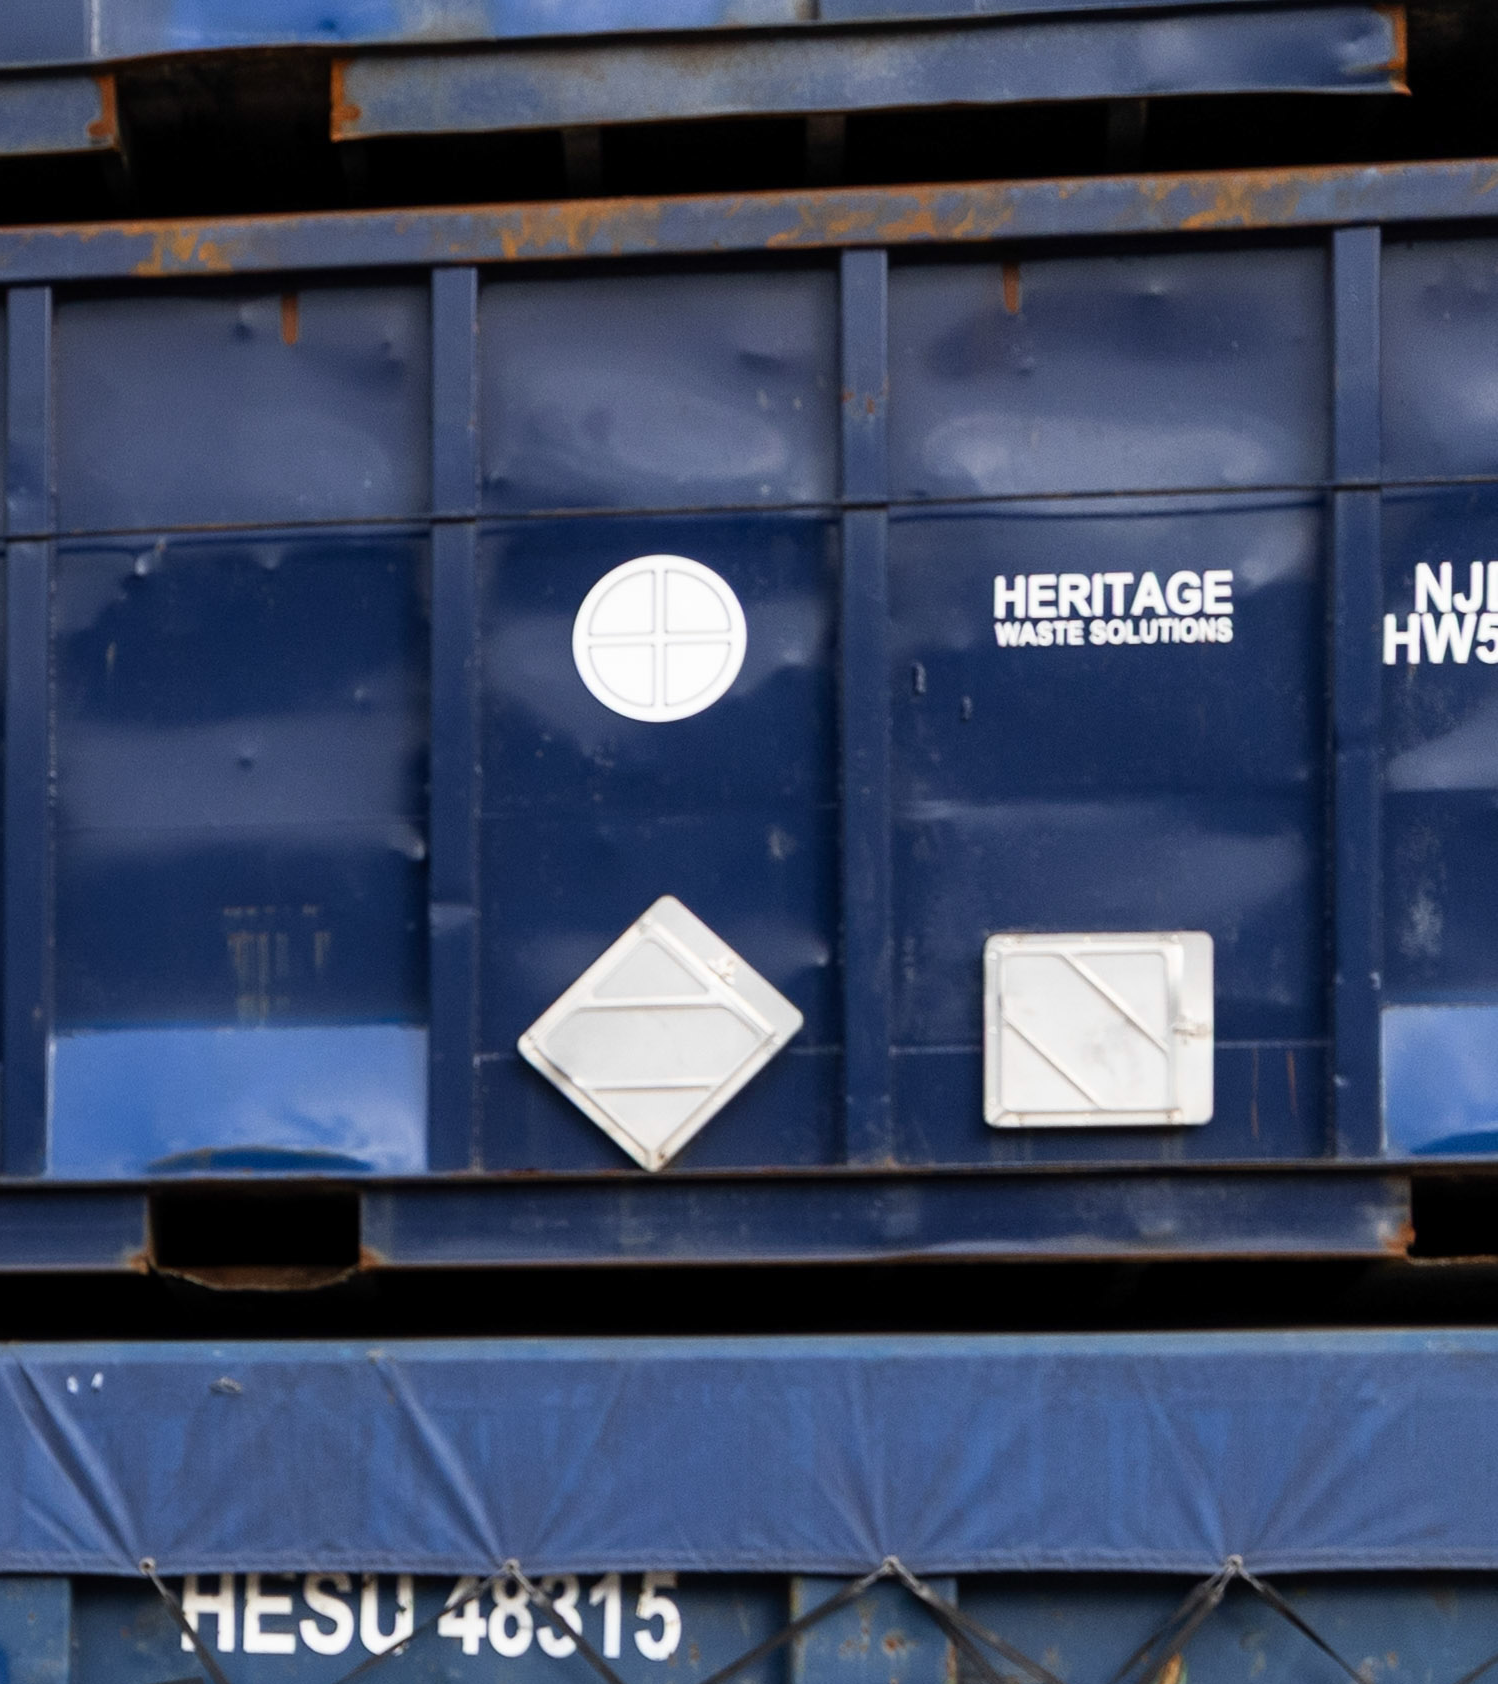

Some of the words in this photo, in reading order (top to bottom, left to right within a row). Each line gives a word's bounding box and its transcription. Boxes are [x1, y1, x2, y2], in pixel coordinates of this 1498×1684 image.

[994, 569, 1234, 619] HERITAGE
[995, 618, 1084, 648] WASTE
[1089, 616, 1234, 646] SOLUTIONS
[179, 1572, 414, 1656] HESU
[436, 1572, 683, 1662] 48315
